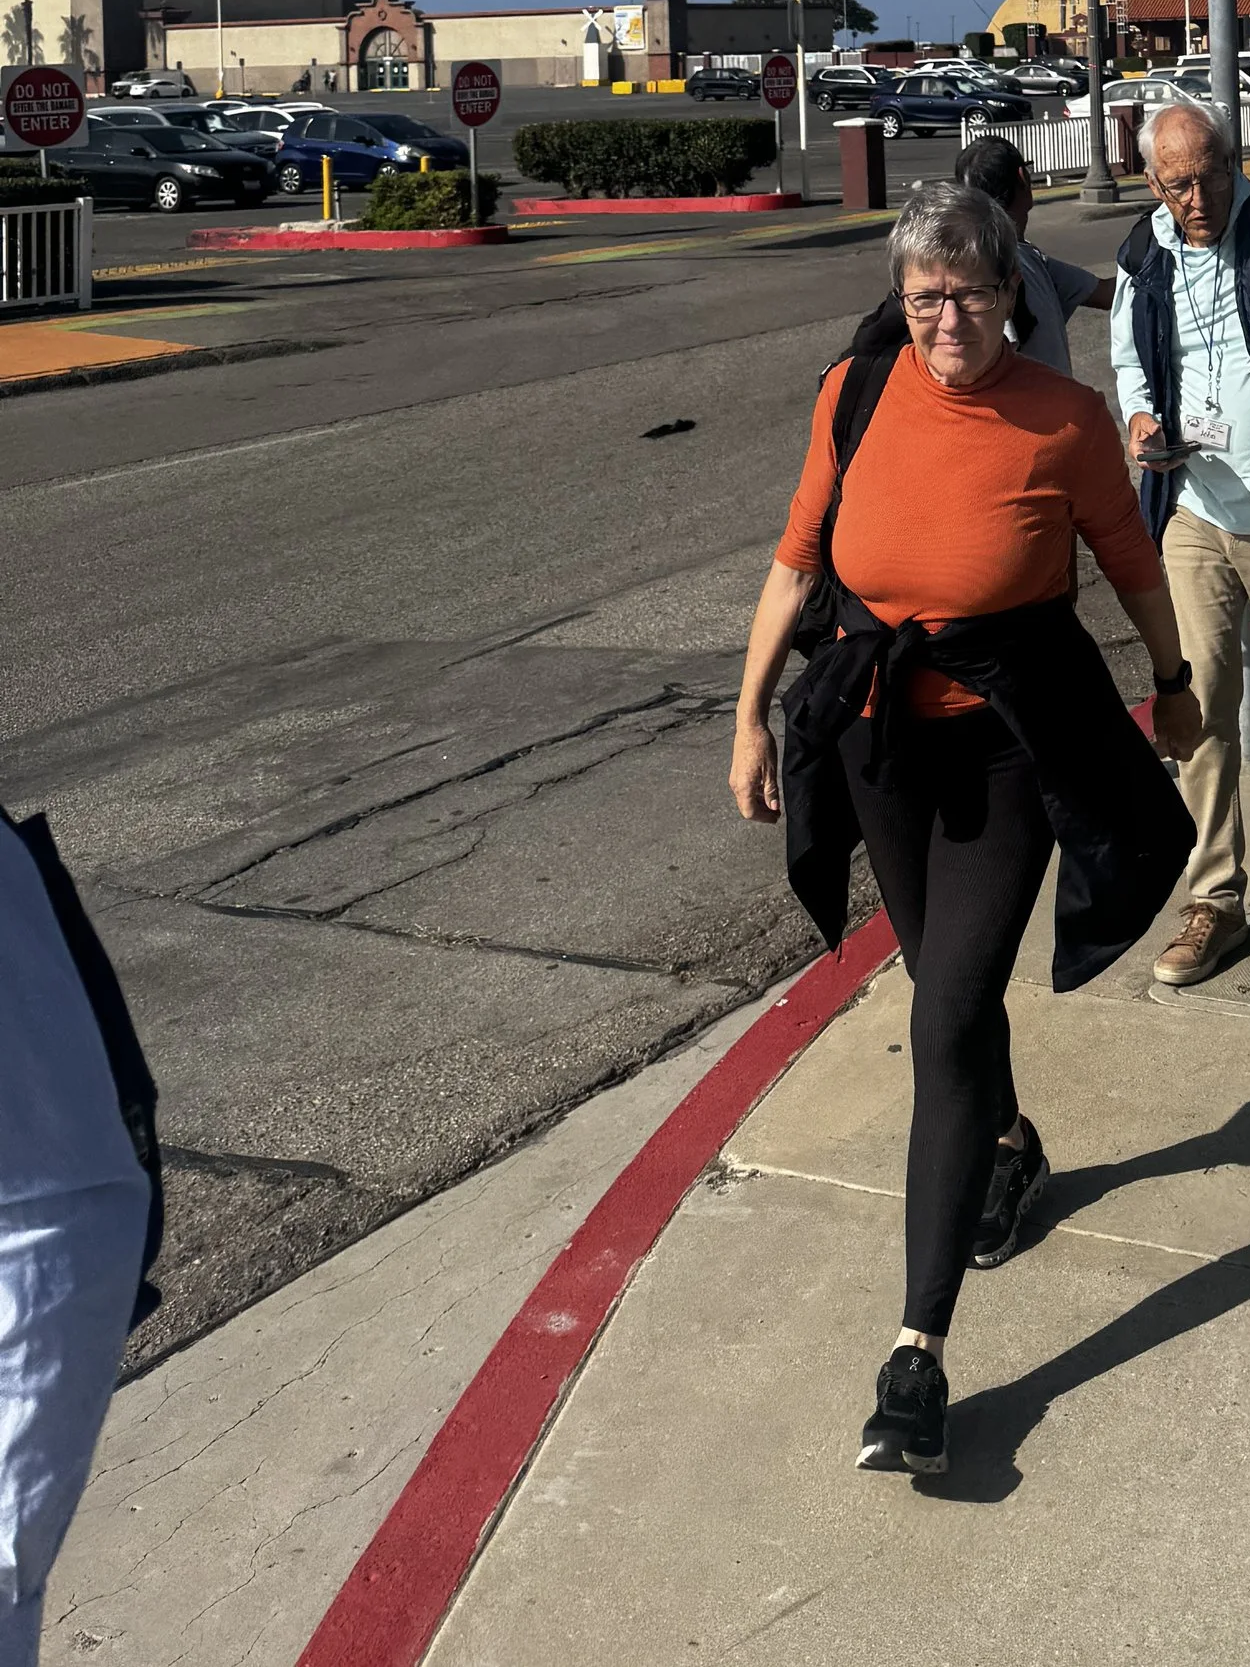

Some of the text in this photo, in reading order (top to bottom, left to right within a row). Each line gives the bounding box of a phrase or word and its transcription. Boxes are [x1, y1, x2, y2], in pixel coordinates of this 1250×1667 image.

[459, 74, 493, 88] DO NOT
[15, 82, 70, 99] DO NOT
[460, 101, 492, 115] ENTER
[21, 115, 70, 132] ENTER
